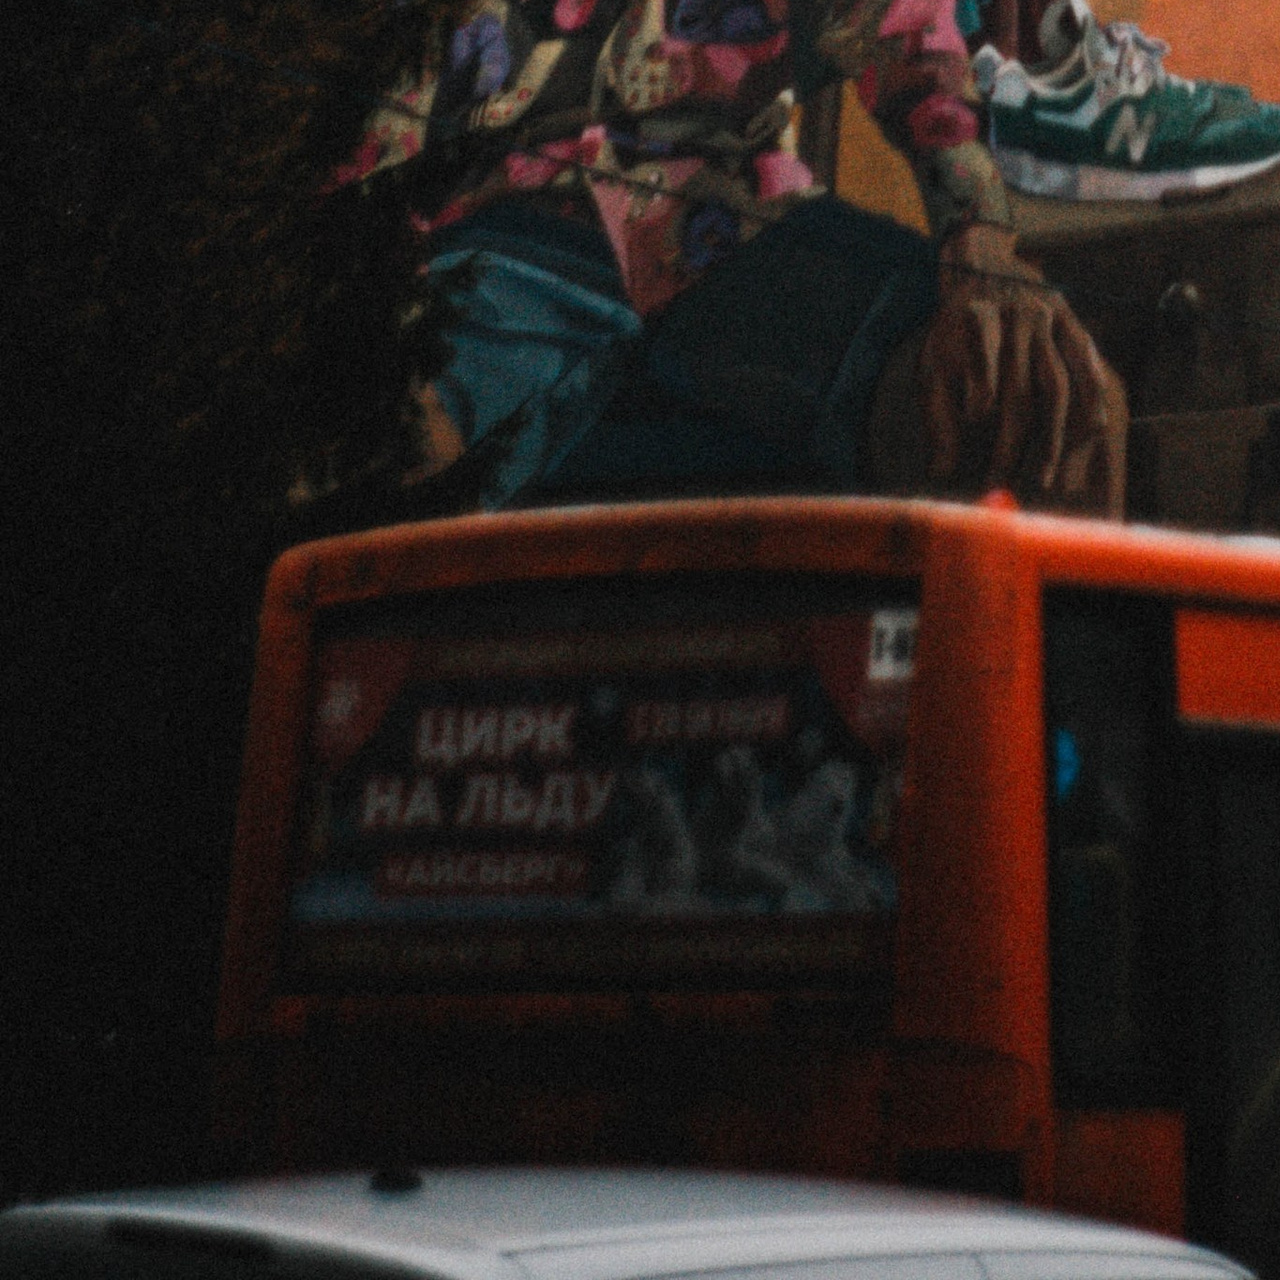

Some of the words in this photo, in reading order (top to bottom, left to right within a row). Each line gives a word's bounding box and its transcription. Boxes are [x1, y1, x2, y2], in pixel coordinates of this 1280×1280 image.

[413, 704, 580, 767] ЦИРК
[360, 773, 443, 829] НА
[456, 770, 617, 831] ЛЬДУ
